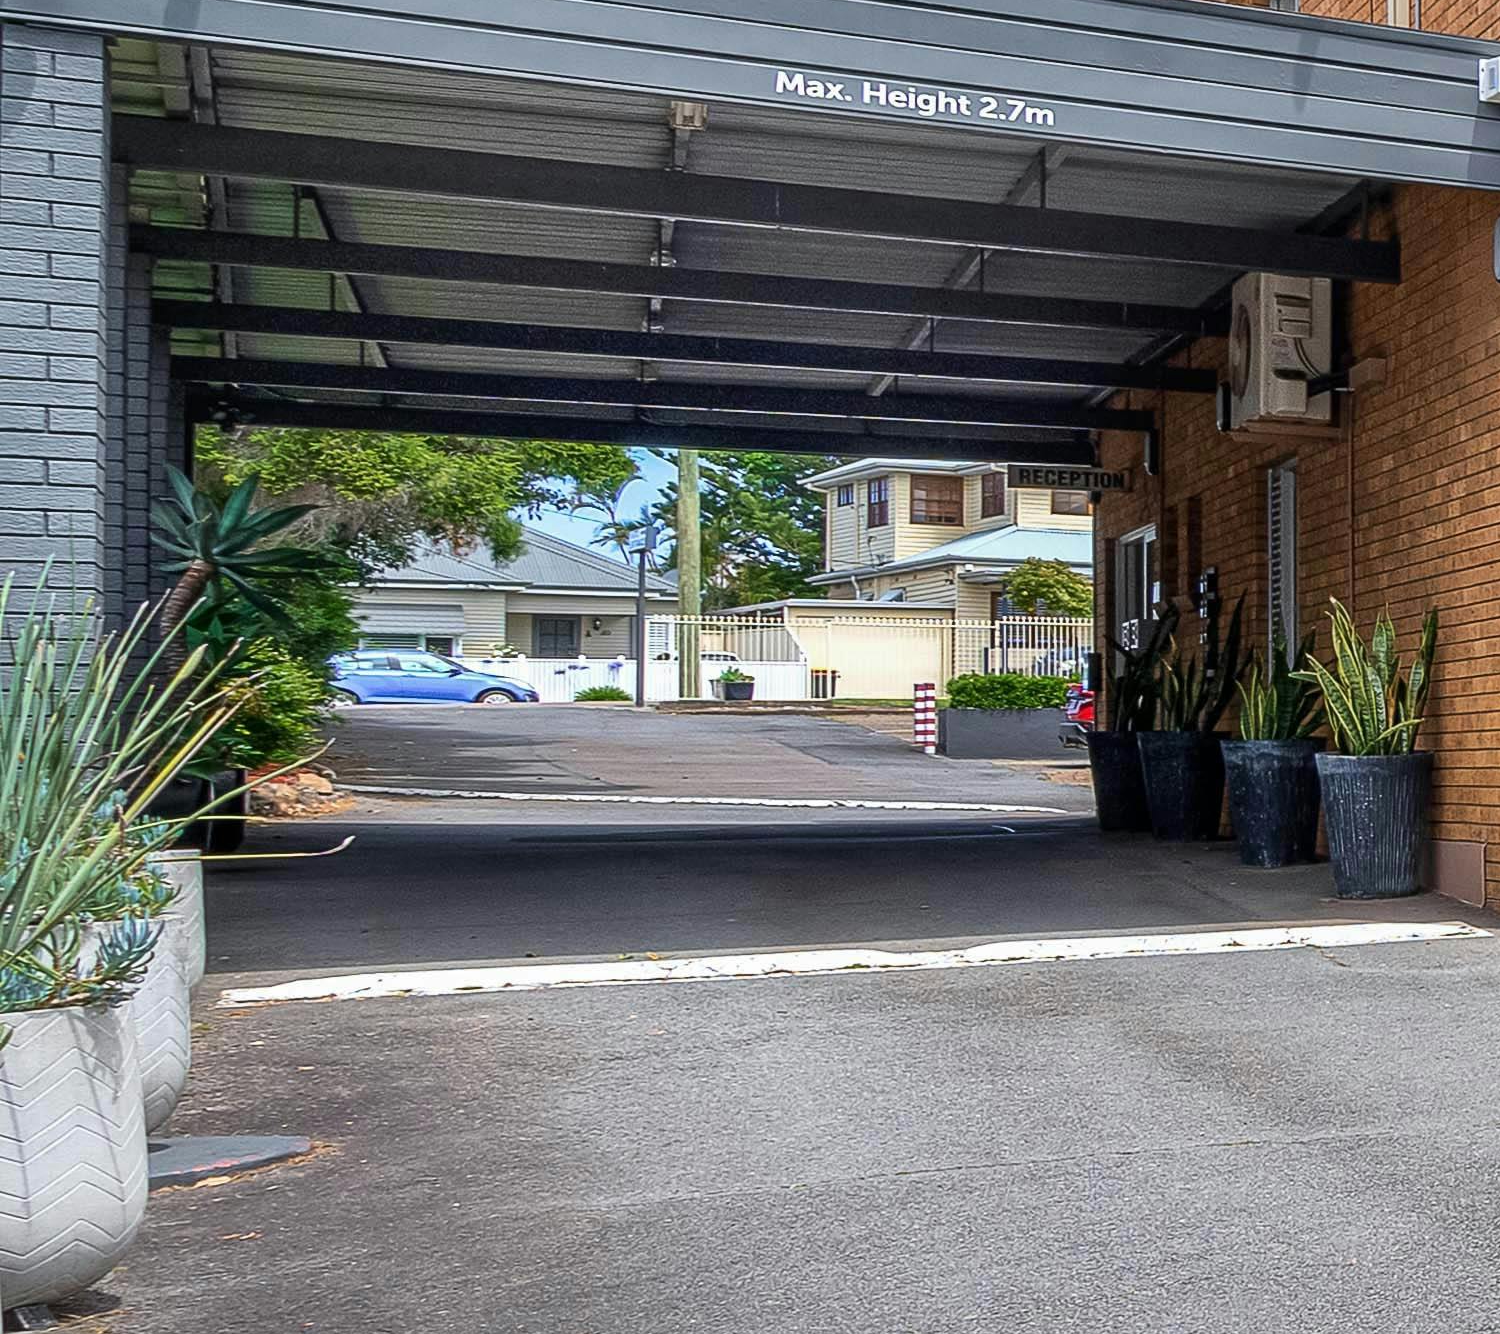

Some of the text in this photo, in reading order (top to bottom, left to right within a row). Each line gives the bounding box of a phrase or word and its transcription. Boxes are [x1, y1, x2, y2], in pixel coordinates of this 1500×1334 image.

[775, 70, 1055, 126] Max. Height 2.7m
[1019, 467, 1126, 488] RECEPTION
